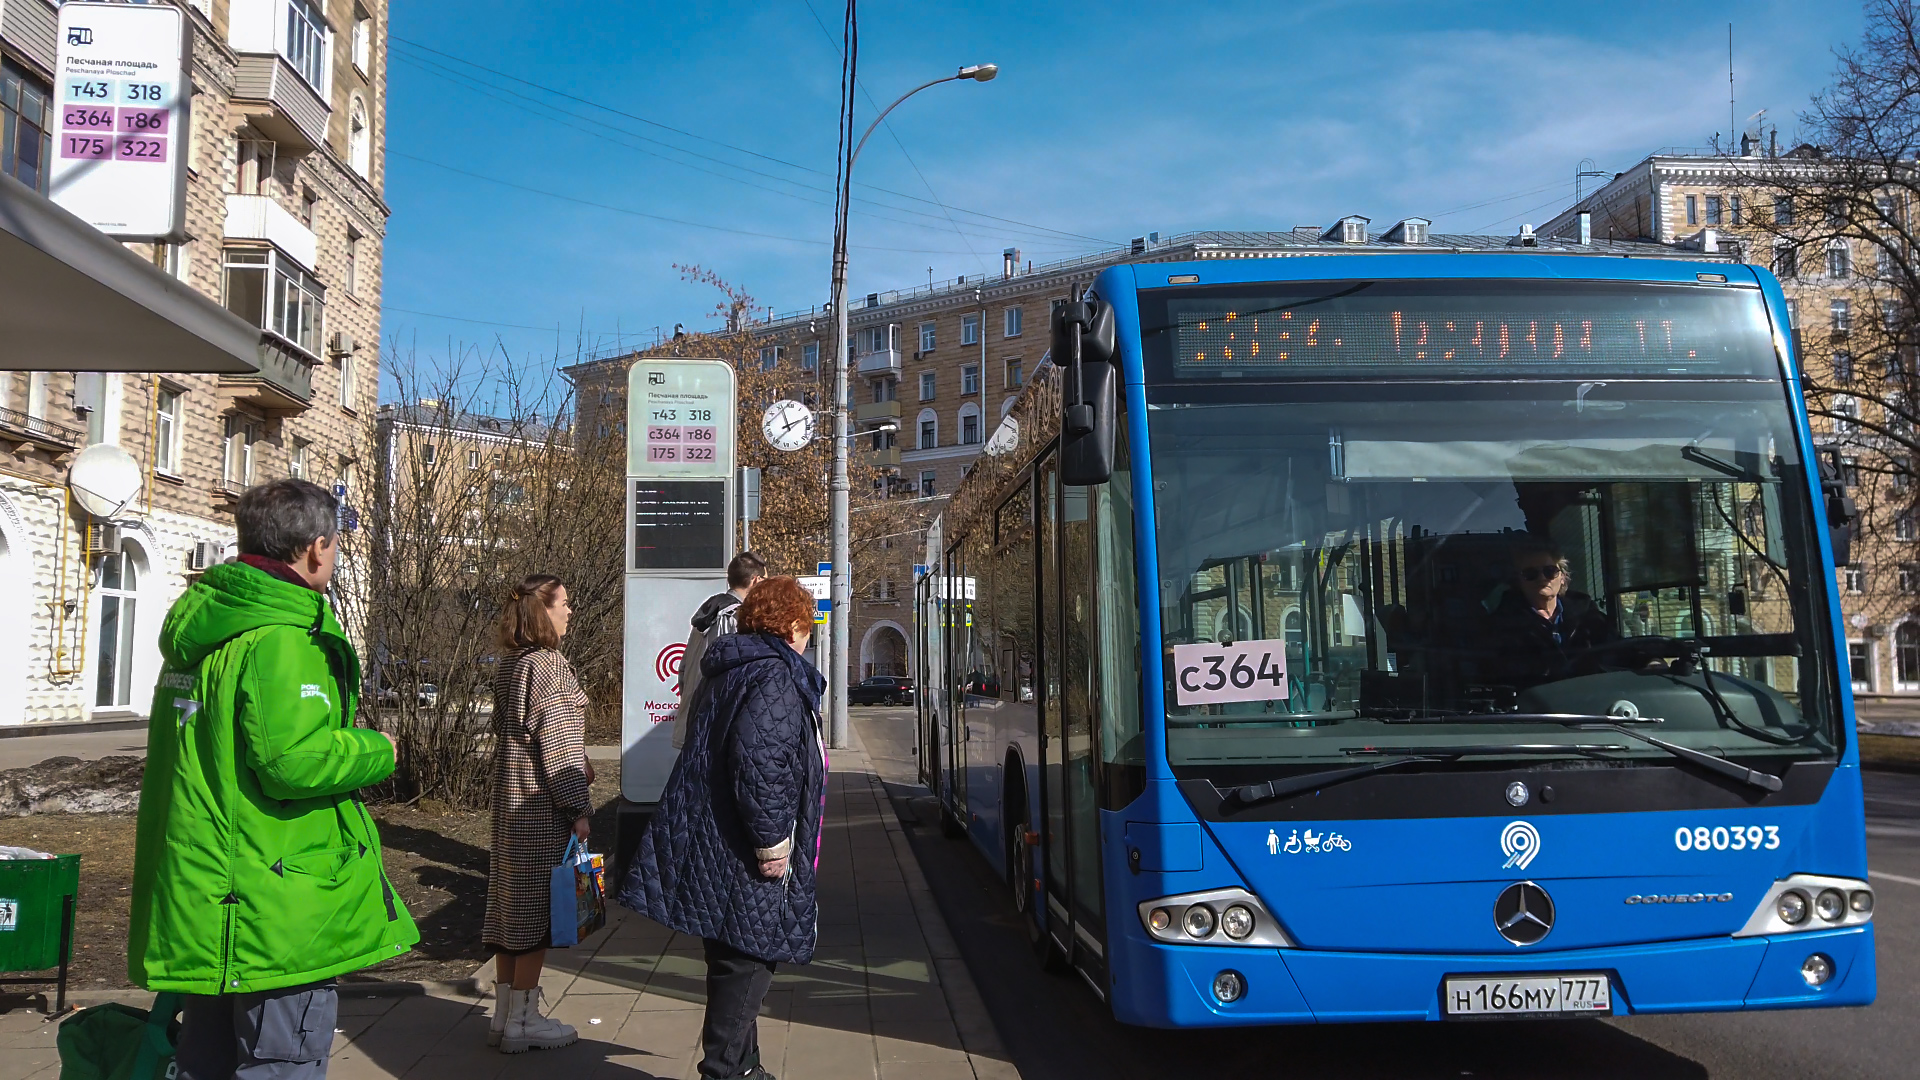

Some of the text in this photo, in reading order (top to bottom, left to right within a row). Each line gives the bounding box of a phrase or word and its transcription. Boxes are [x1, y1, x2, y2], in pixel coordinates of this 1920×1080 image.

[66, 56, 158, 69] Песчаная площадь
[65, 67, 105, 75] Peschanaya
[72, 82, 162, 101] т43 318
[65, 110, 162, 129] с364 т86
[70, 138, 161, 157] 175 322
[652, 409, 711, 421] т43 318
[649, 429, 712, 440] с364 т86
[652, 447, 712, 459] 175 322
[1180, 653, 1284, 692] с364
[643, 700, 680, 710] Моско
[649, 712, 677, 724] Тран
[1675, 825, 1780, 851] 080393
[1624, 892, 1734, 905] CONECTO
[1562, 980, 1601, 1000] 777
[1573, 1001, 1593, 1009] RUS
